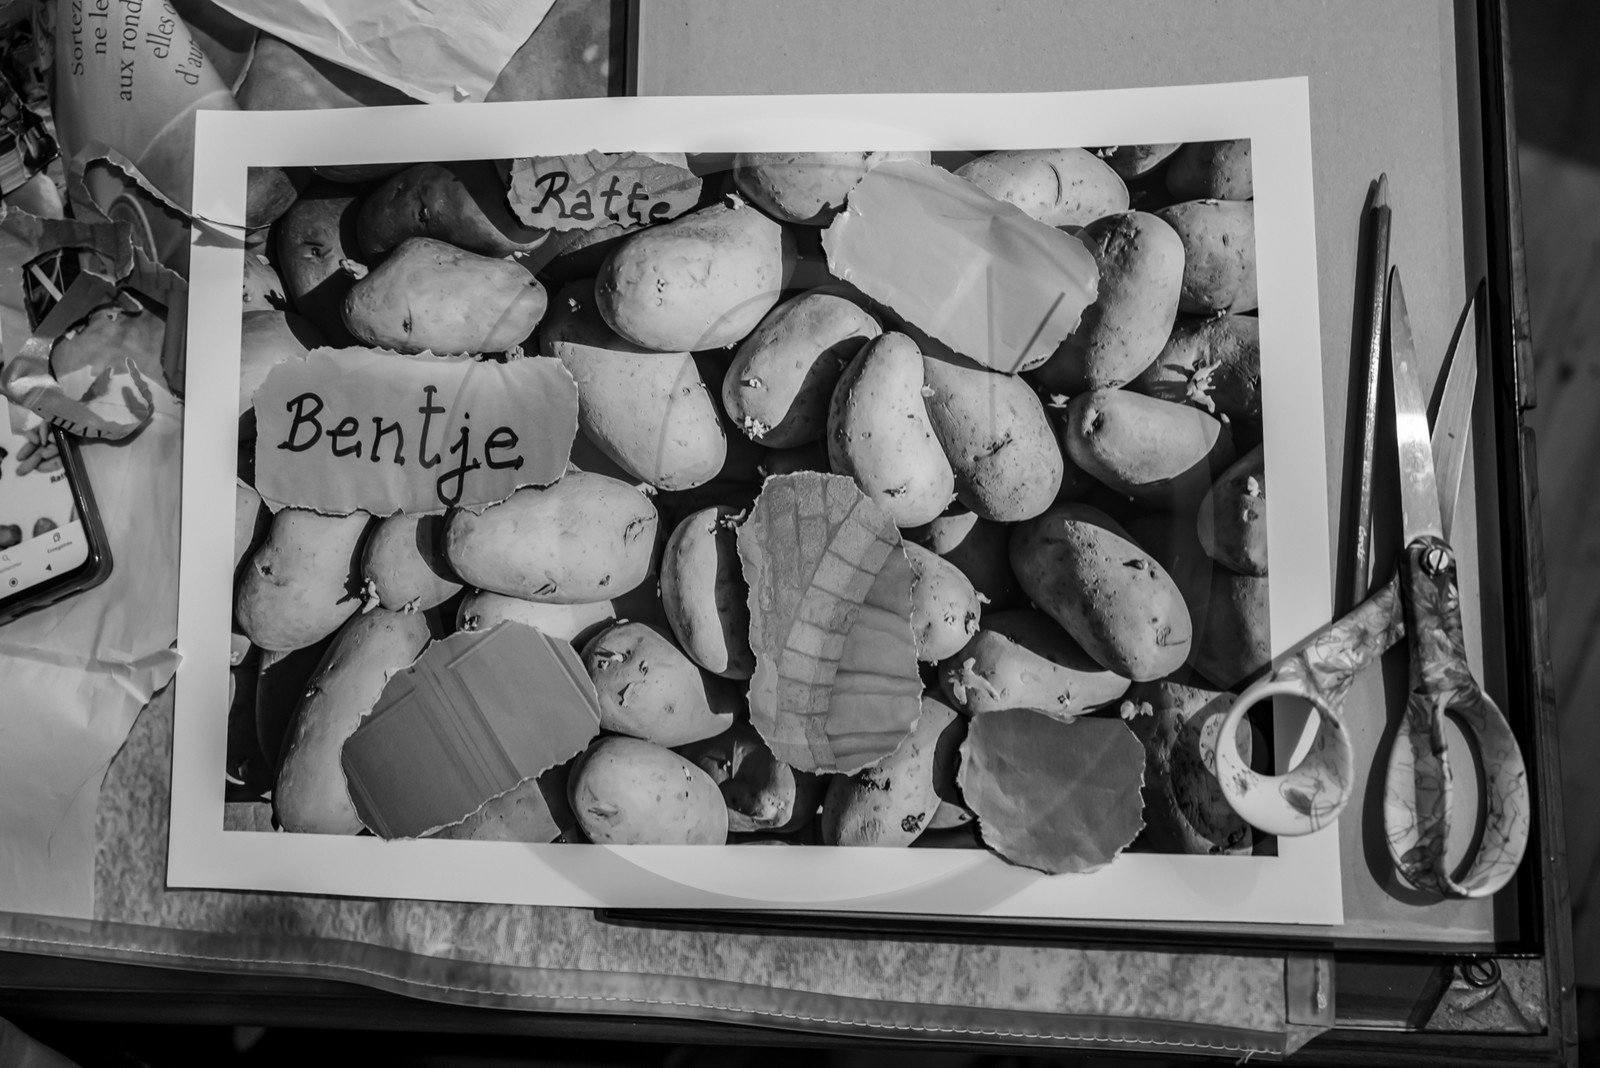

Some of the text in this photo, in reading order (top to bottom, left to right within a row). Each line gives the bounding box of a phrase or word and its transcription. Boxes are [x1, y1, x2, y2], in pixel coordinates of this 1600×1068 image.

[71, 0, 84, 76] Sortez
[95, 27, 108, 55] ne
[145, 16, 176, 59] elles
[120, 59, 135, 102] aux
[531, 171, 671, 222] Ratte
[277, 385, 524, 506] Bentje
